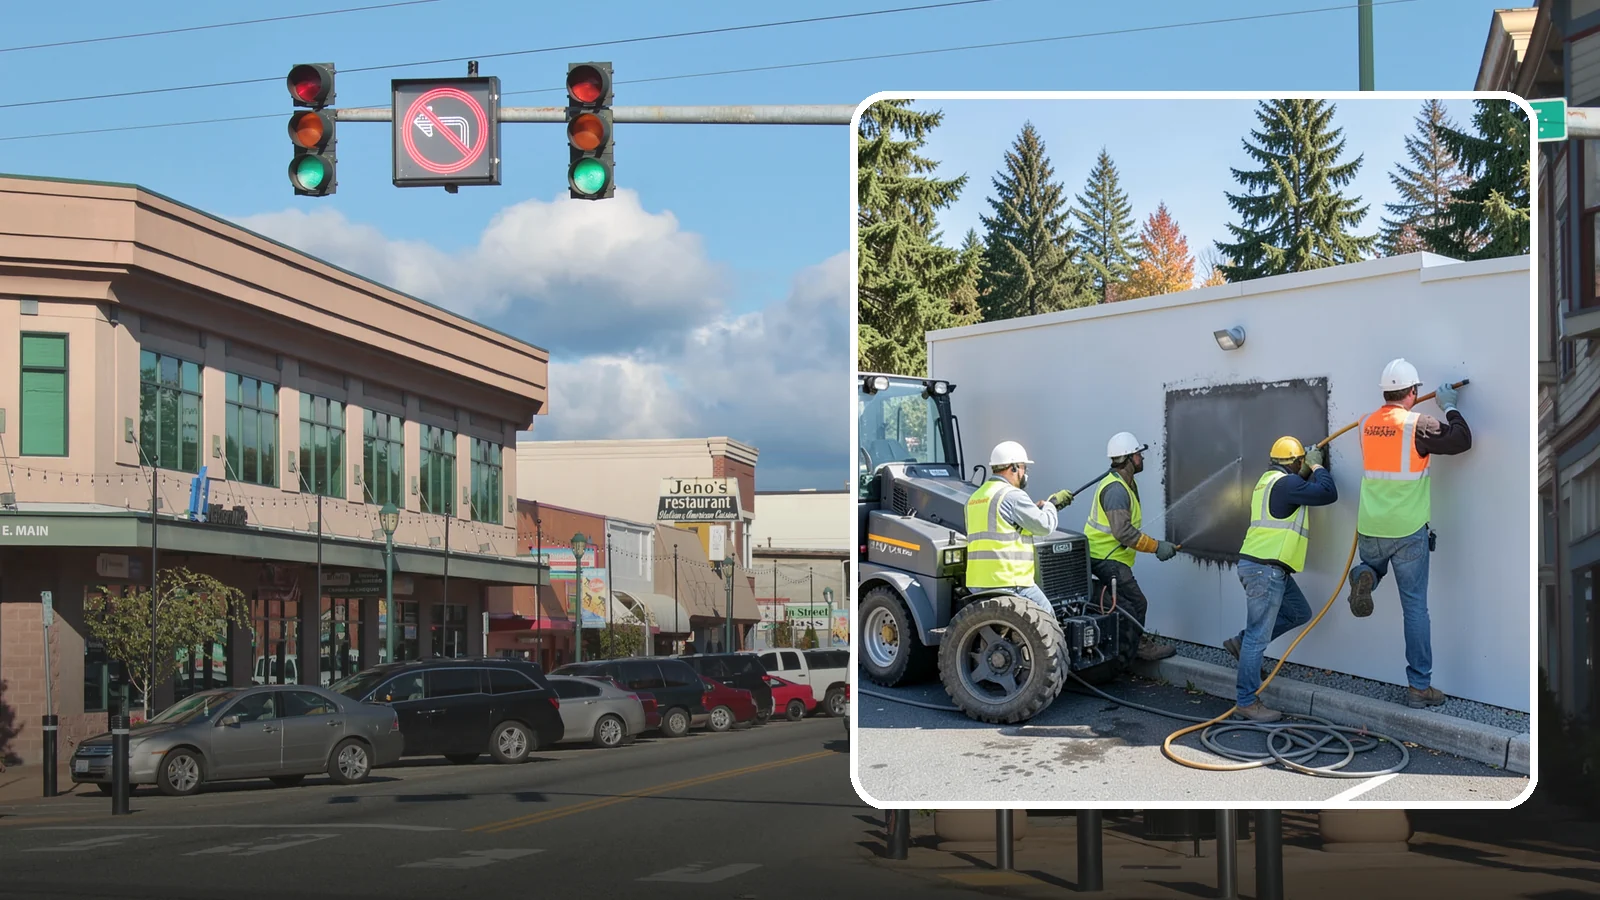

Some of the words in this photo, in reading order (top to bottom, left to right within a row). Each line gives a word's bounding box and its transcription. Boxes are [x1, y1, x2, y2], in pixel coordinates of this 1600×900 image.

[669, 480, 728, 495] Jeno's
[665, 496, 731, 509] restaurant
[658, 509, 682, 520] Italian
[686, 509, 714, 519] American
[715, 509, 738, 519] Cuisine
[2, 525, 13, 536] E.
[15, 525, 49, 536] MAIN
[797, 607, 829, 617] Street
